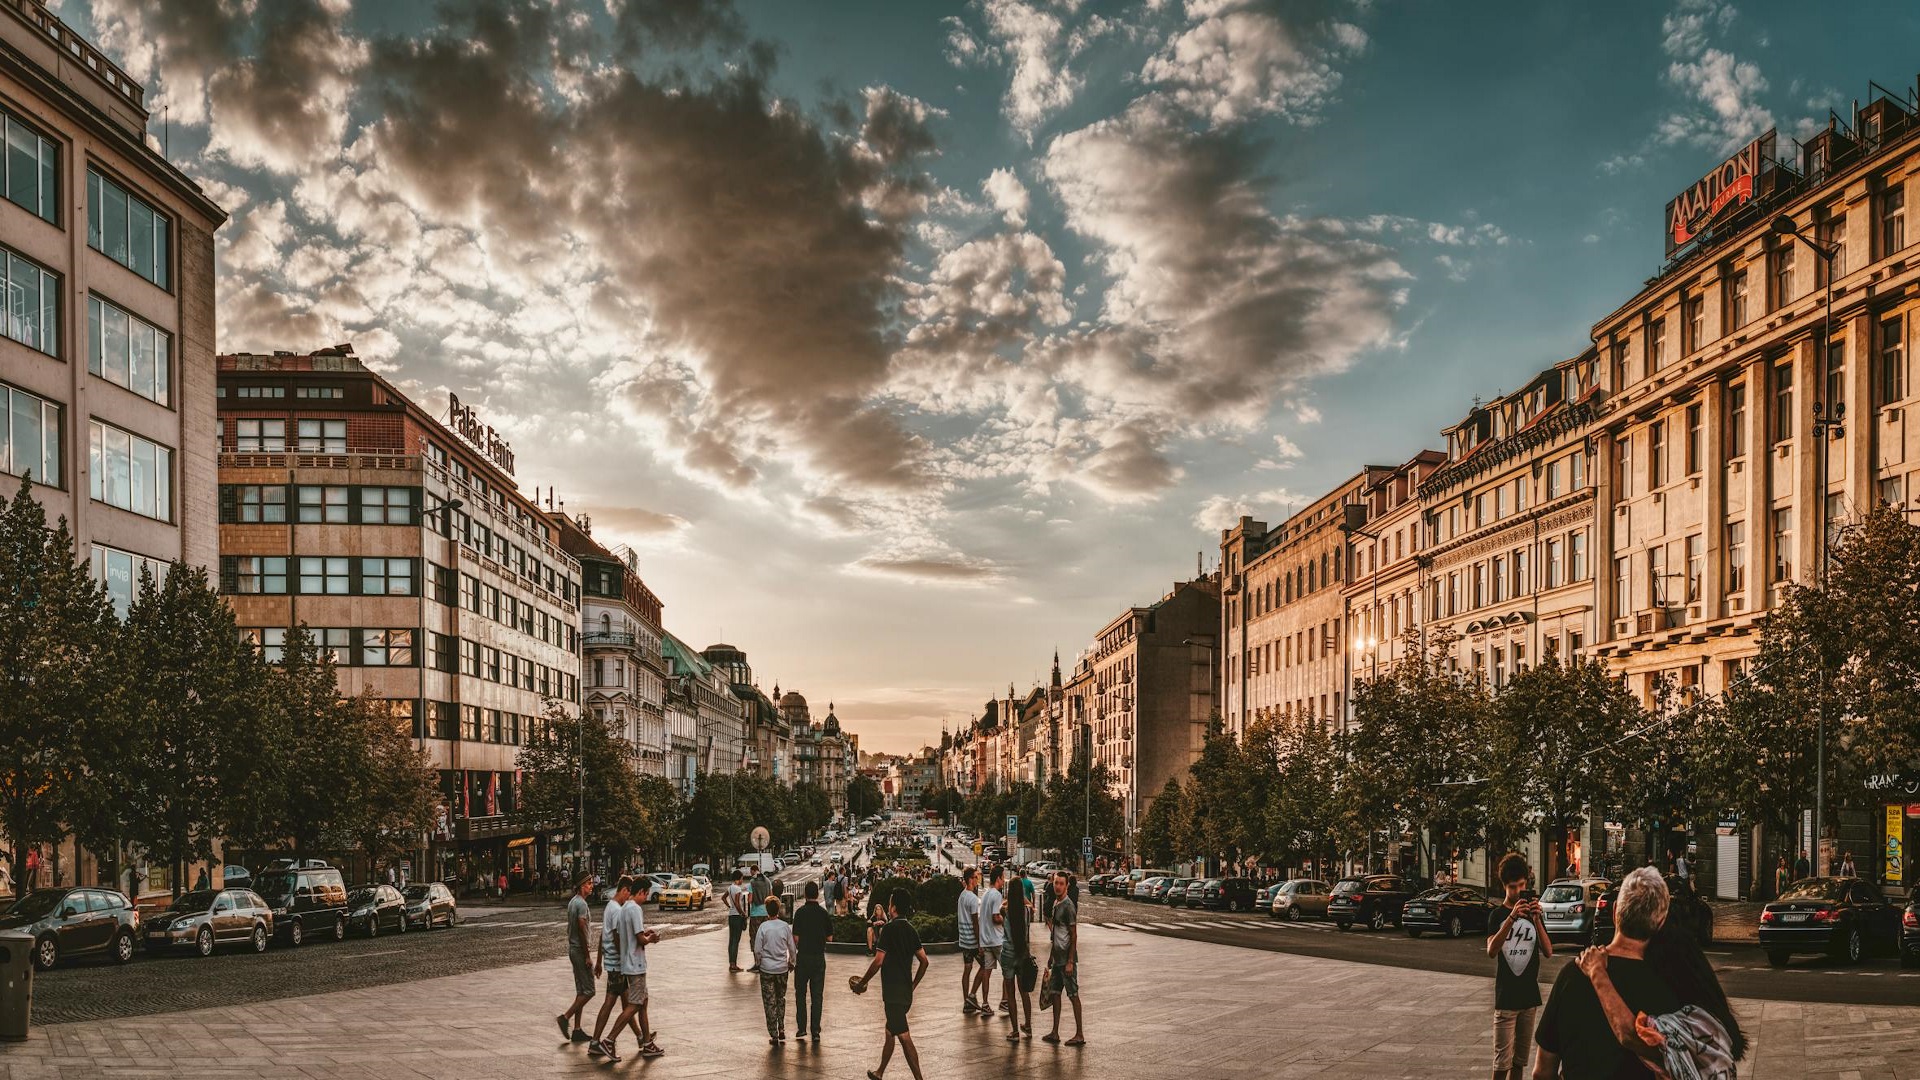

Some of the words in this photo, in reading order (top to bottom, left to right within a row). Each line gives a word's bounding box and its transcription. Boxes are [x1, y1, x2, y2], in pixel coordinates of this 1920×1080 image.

[449, 392, 484, 450] Palác
[109, 564, 128, 581] invia
[1009, 818, 1015, 830] P
